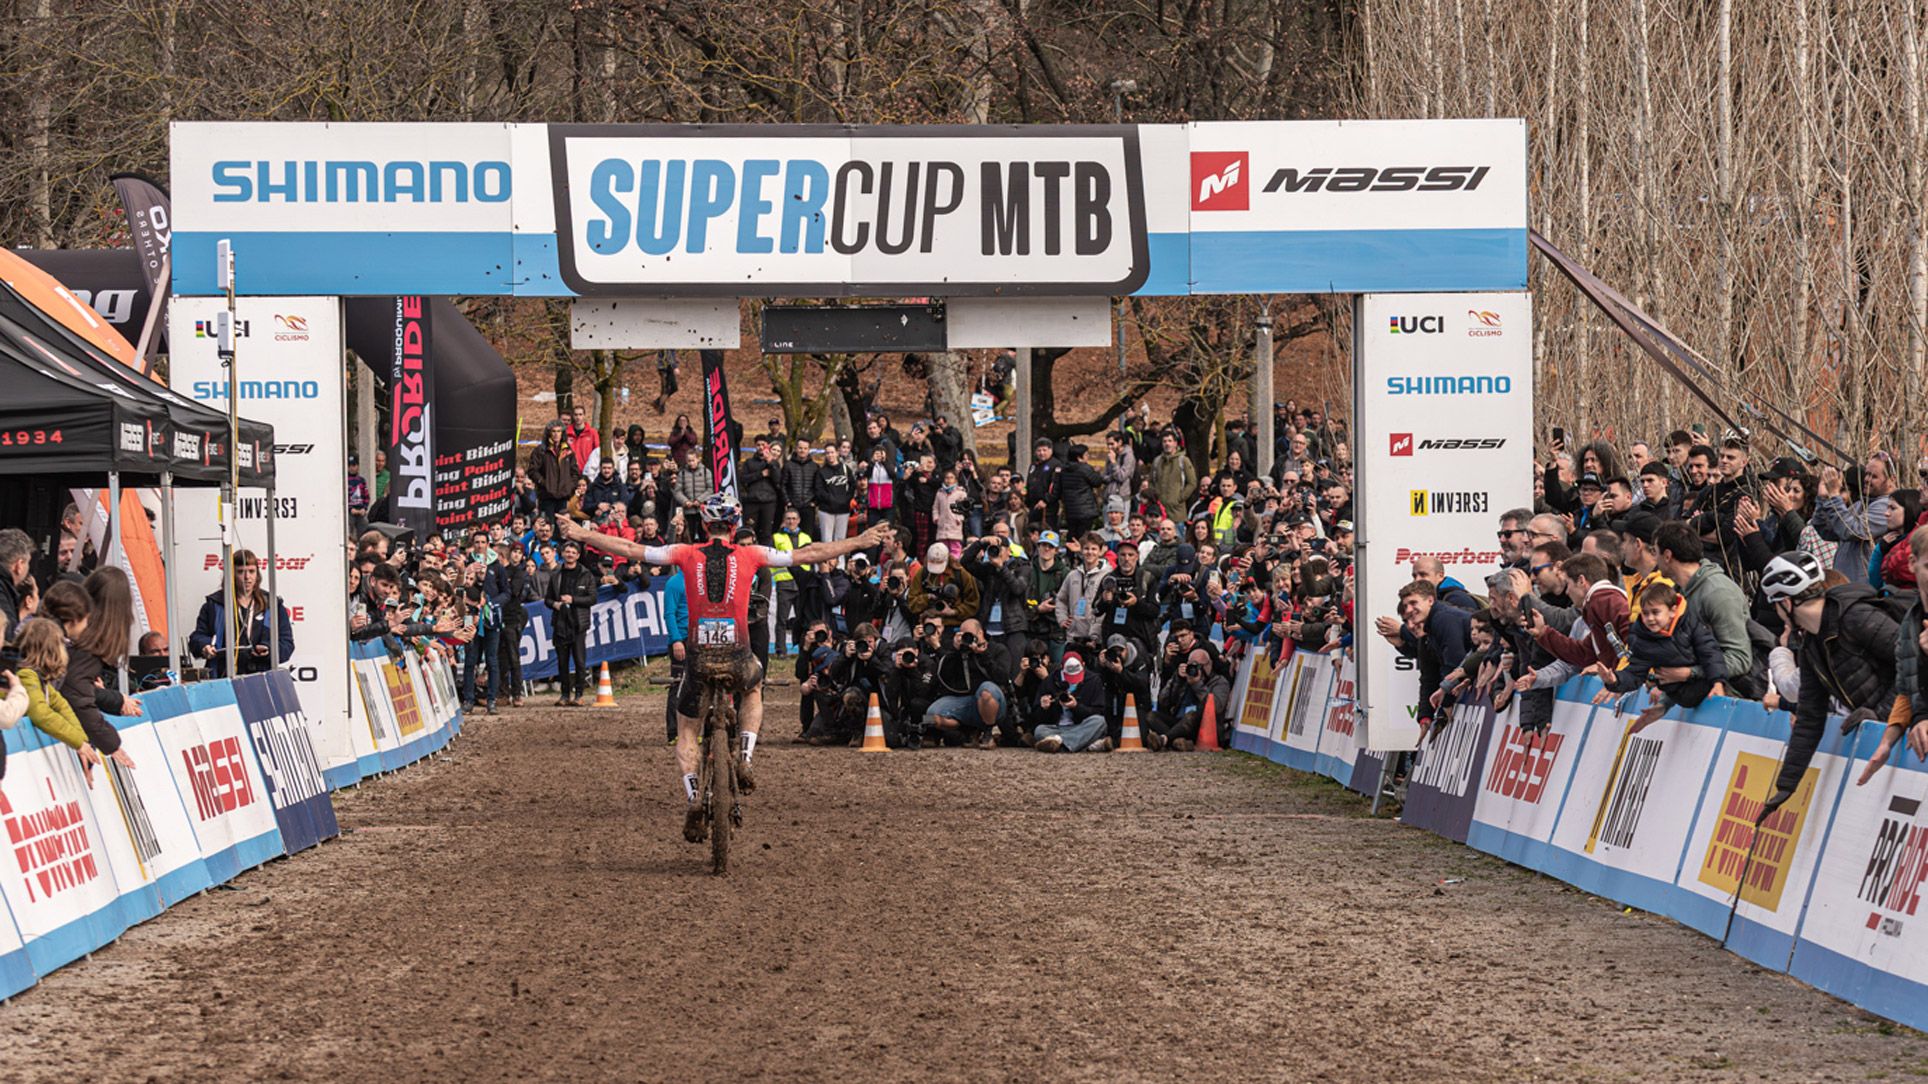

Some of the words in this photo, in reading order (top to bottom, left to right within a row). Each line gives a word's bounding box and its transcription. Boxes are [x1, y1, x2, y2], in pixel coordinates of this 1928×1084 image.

[212, 160, 512, 203] SHIMANO
[1262, 166, 1491, 193] MASSI
[980, 161, 1113, 256] MTB
[1400, 316, 1444, 334] UCI
[193, 380, 319, 399] SHMANO
[1387, 376, 1511, 394] SHIMANO
[1, 430, 64, 446] 1934
[1418, 438, 1506, 450] MASSI
[272, 443, 315, 455] SSI
[466, 439, 513, 461] Biking
[464, 457, 504, 477] Point
[470, 485, 508, 506] Point
[704, 630, 728, 645] 146
